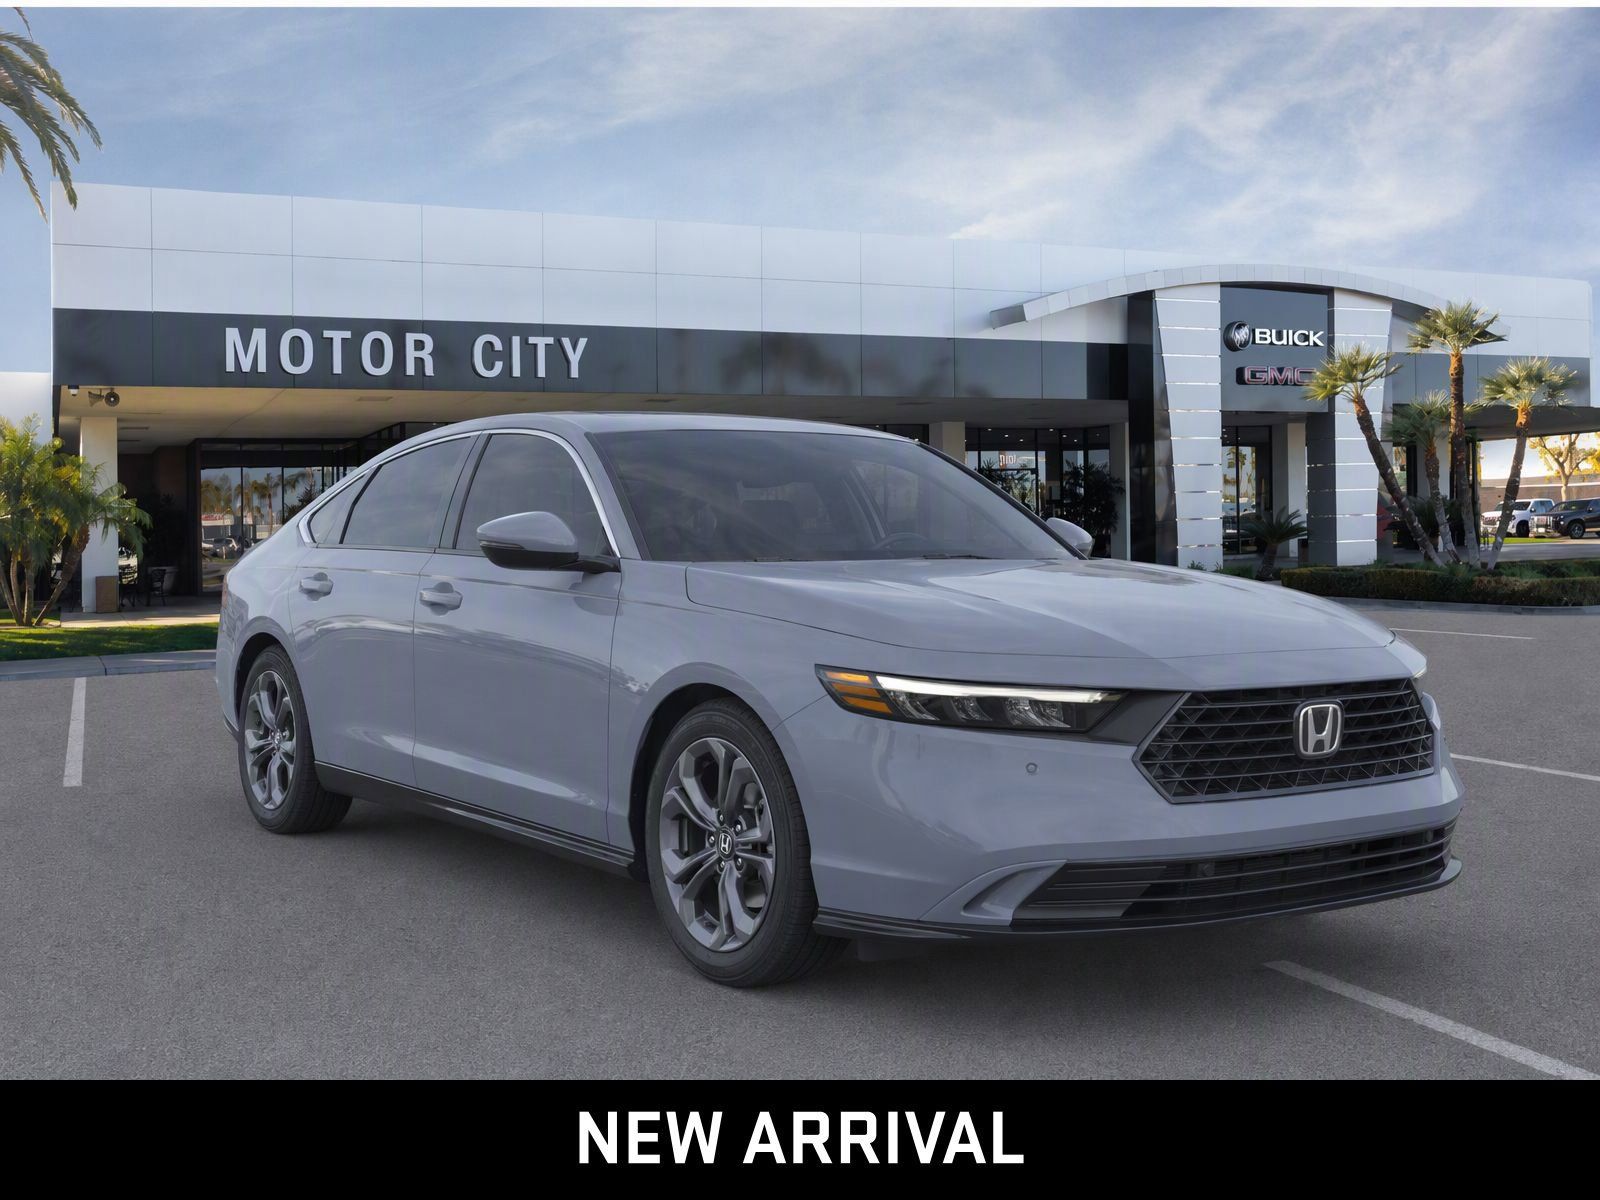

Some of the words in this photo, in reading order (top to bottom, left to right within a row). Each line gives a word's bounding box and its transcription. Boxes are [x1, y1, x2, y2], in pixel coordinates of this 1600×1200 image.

[1254, 328, 1325, 347] BUICK
[225, 327, 435, 377] MOTOR
[472, 333, 588, 379] CITY
[1244, 366, 1316, 385] GMC
